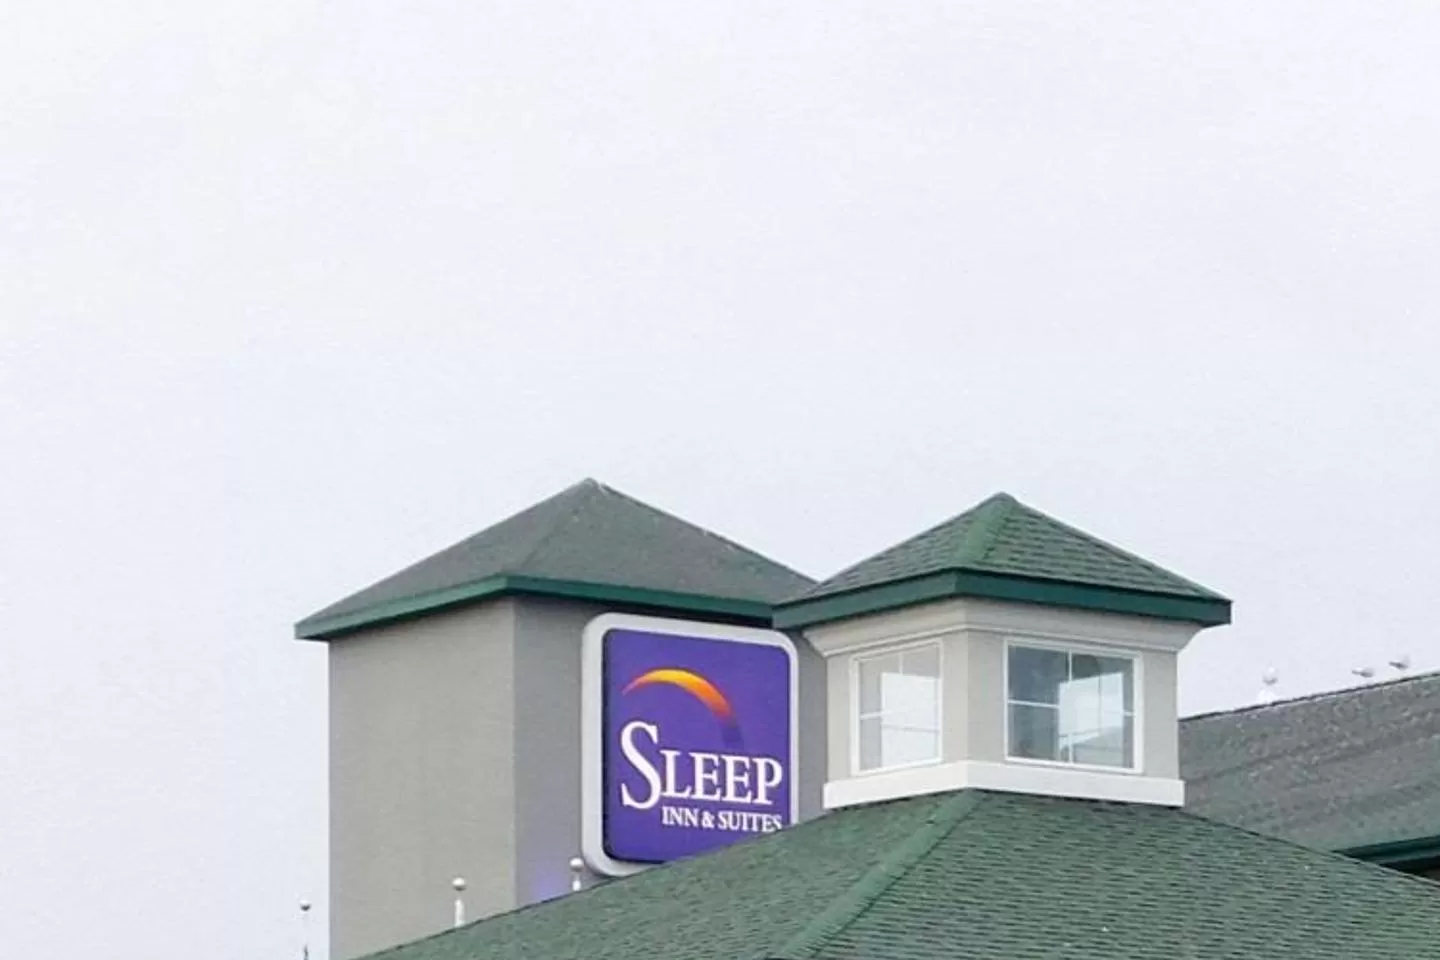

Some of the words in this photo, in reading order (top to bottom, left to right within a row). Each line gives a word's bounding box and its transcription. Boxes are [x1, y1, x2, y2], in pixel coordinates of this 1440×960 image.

[620, 720, 783, 810] SLEEP
[662, 804, 699, 827] INN
[701, 810, 716, 829] &
[717, 810, 783, 832] SUITES
